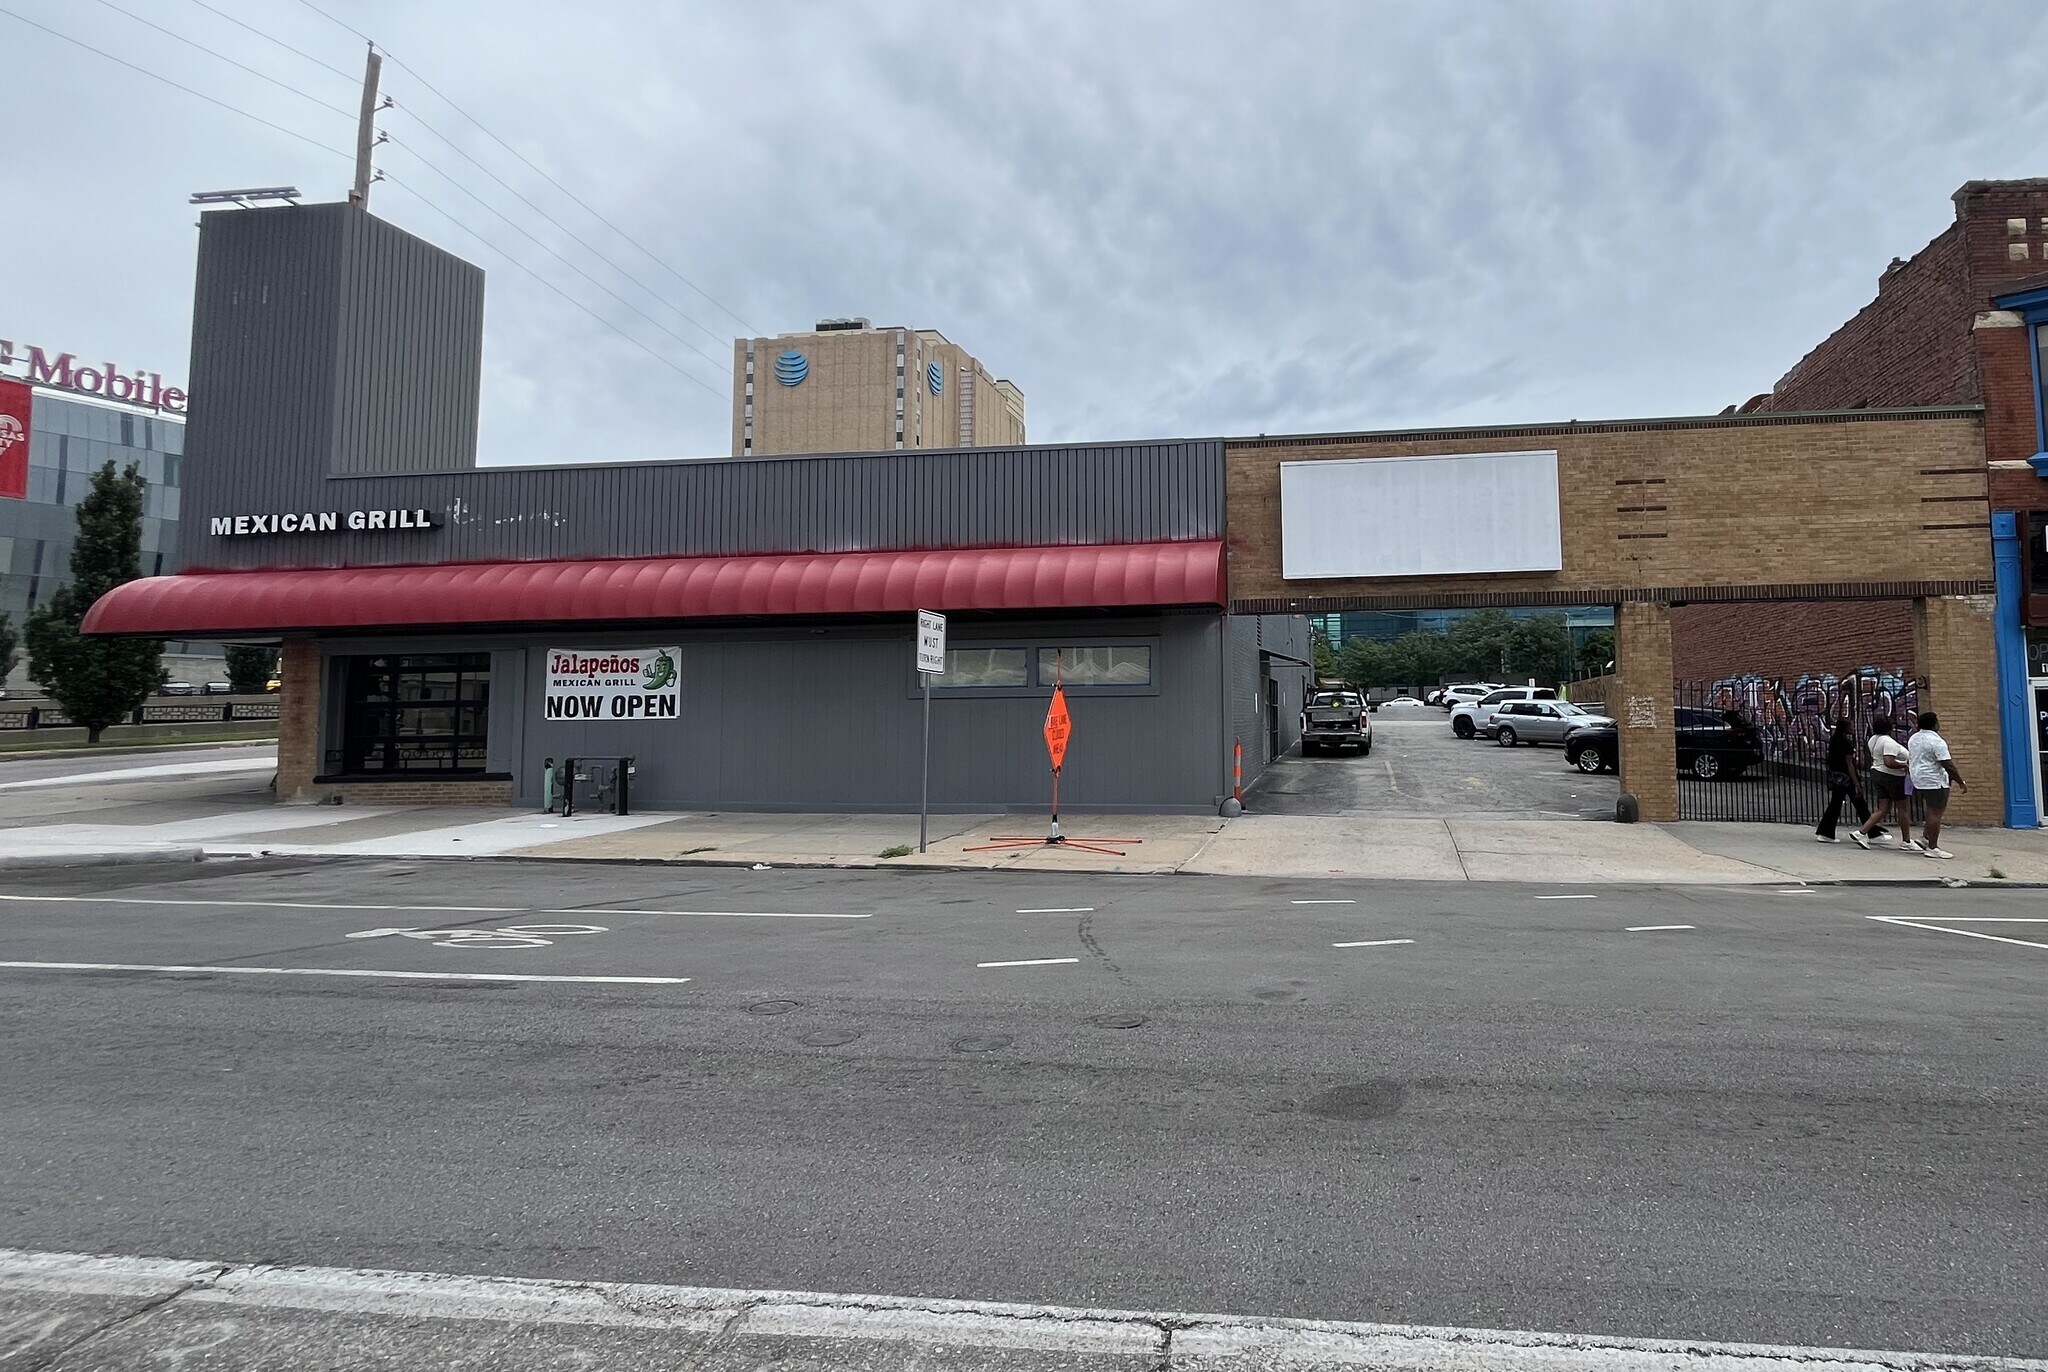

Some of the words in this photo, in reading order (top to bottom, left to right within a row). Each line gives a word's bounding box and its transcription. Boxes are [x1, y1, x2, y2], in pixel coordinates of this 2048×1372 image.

[211, 512, 336, 535] MEXICAN
[348, 509, 431, 529] GRILL
[551, 654, 640, 678] Jalapeños
[553, 678, 601, 687] MEXICAN
[605, 678, 636, 687] GRILL
[547, 695, 603, 718] NOW
[611, 694, 676, 717] OPEN
